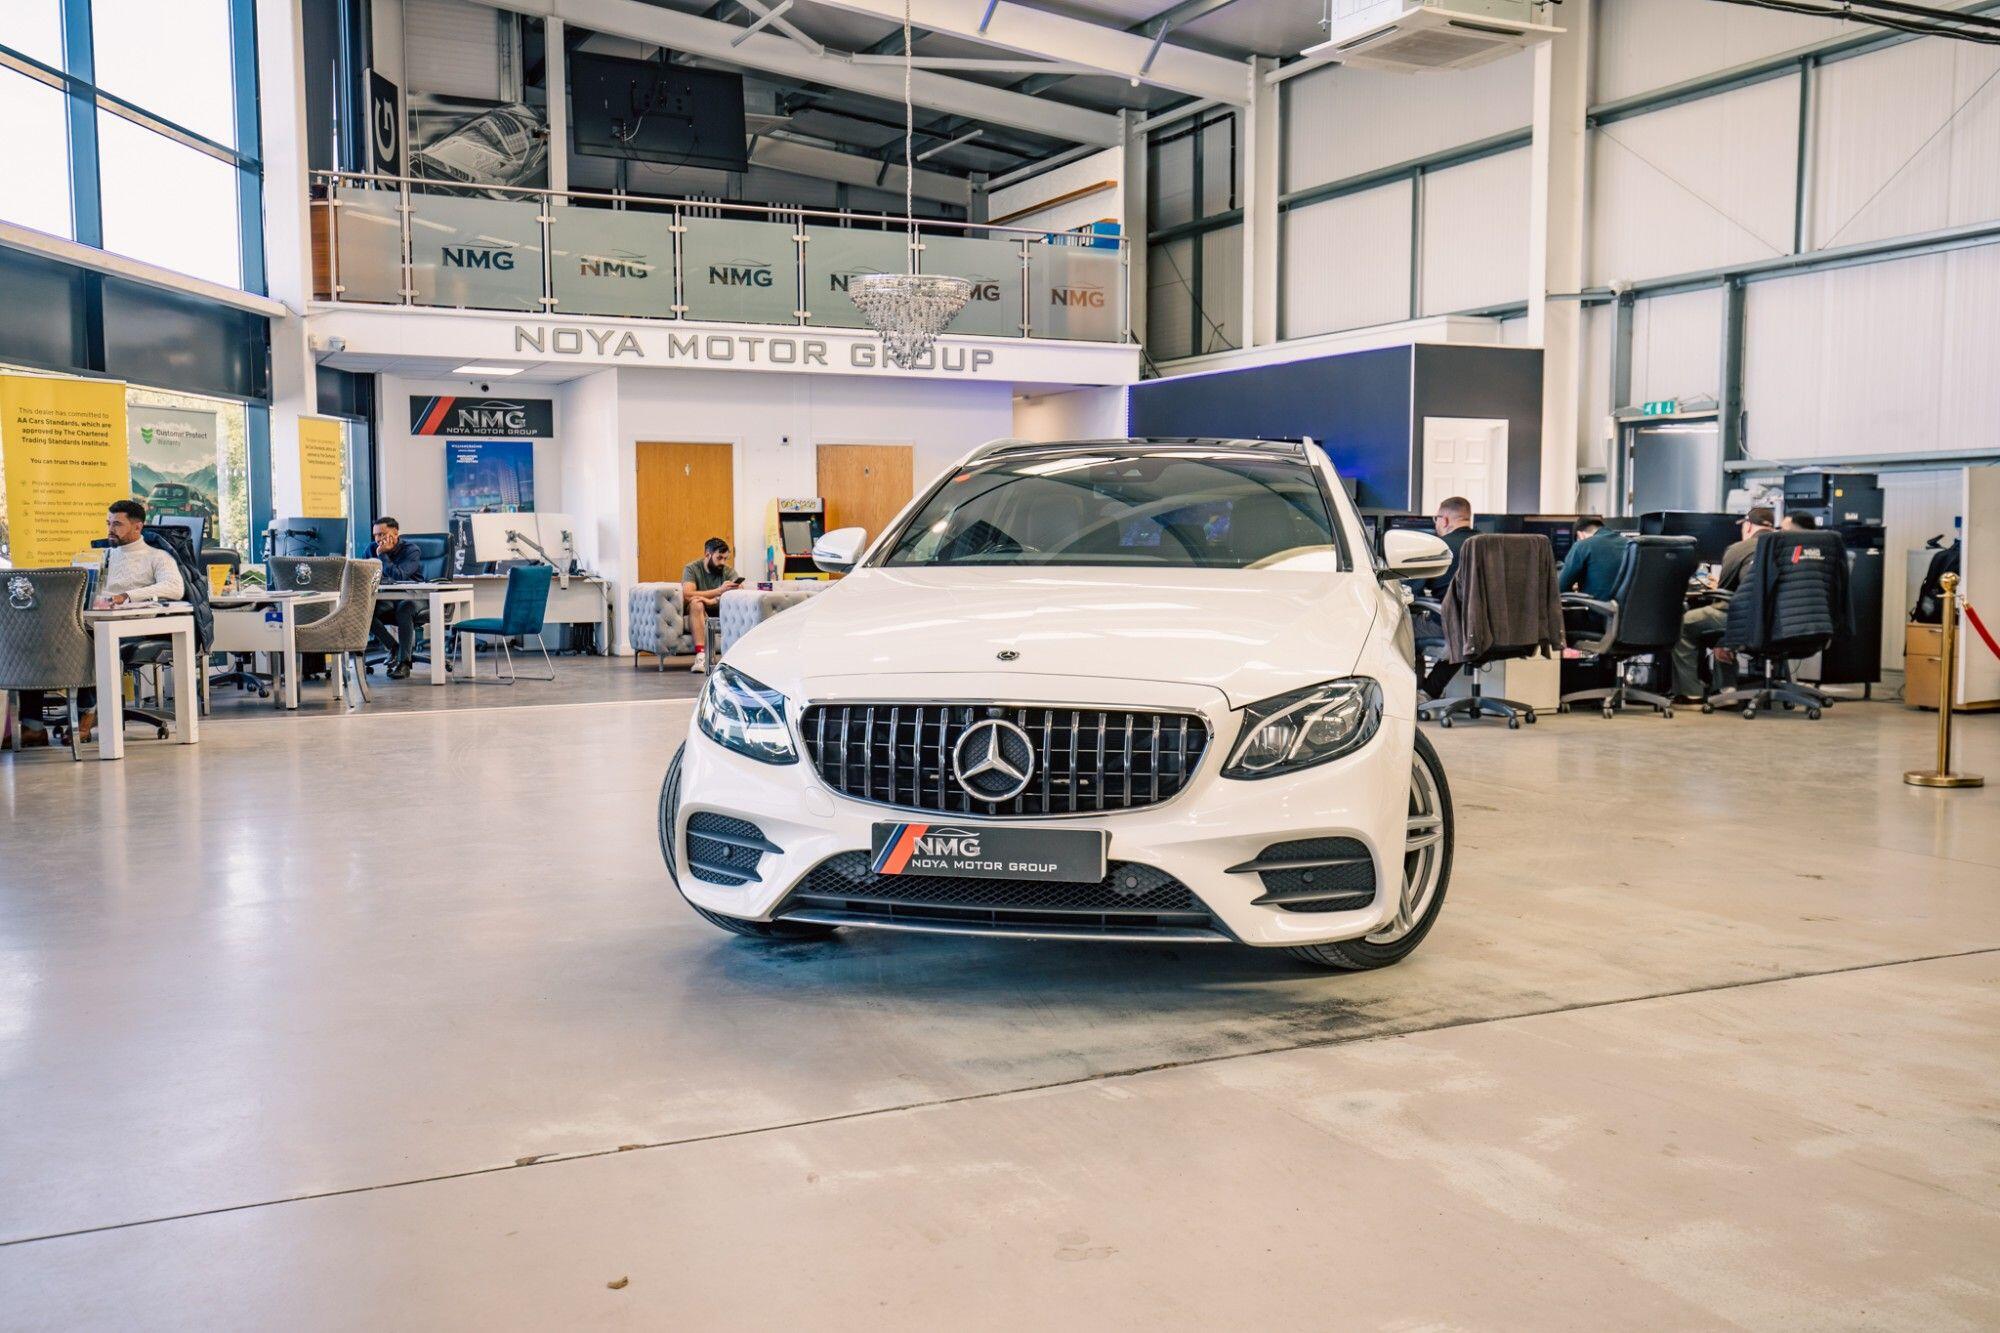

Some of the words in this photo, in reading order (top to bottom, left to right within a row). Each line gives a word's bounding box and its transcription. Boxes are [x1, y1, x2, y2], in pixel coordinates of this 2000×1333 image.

[441, 247, 515, 270] NMG
[580, 257, 648, 279] NMG
[709, 265, 774, 287] NMG
[1050, 289, 1105, 308] NMG
[515, 326, 644, 357] NOYA
[668, 333, 829, 365] MOTOR
[458, 409, 526, 429] NMG
[22, 437, 47, 445] Trading
[48, 438, 81, 446] Standards
[156, 429, 185, 438] Customer
[185, 431, 208, 440] Protect
[913, 836, 981, 857] NMG
[912, 859, 949, 868] NOYA
[954, 860, 1003, 871] MOTOR
[1008, 862, 1058, 873] GROUP
